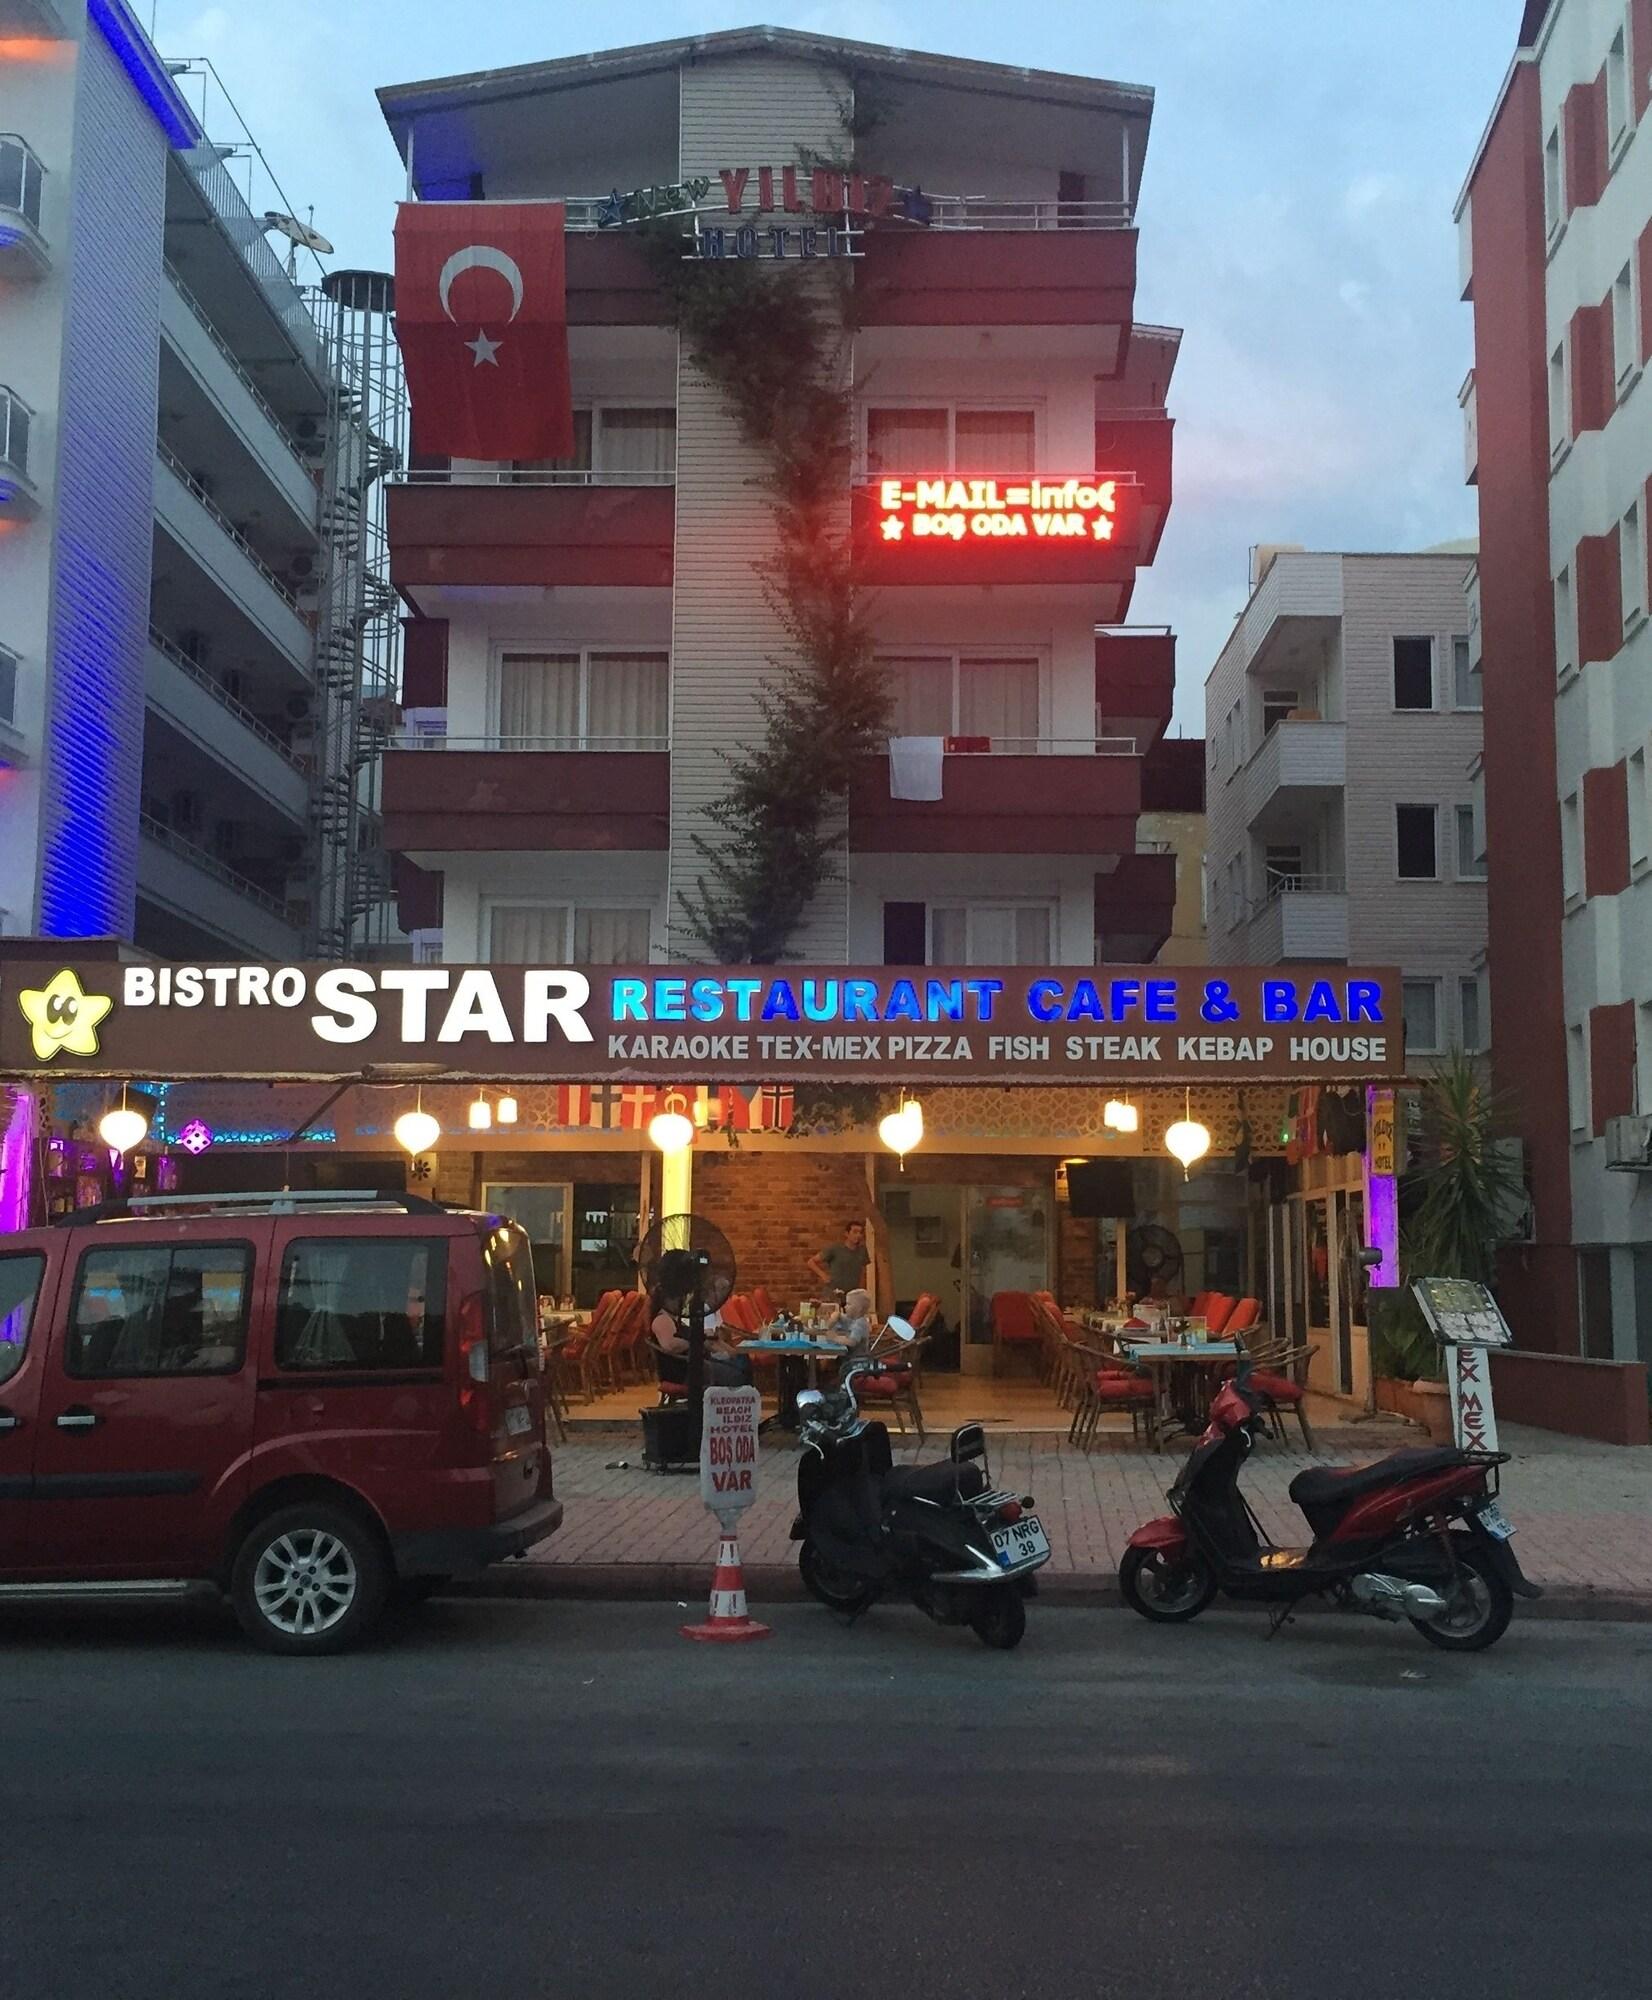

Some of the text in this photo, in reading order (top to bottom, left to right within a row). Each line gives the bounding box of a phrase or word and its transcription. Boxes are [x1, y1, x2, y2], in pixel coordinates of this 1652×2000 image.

[703, 226, 839, 259] HOTEL
[912, 513, 1087, 541] BOŞ ODA VAR
[123, 967, 594, 1044] BISTRO STAR
[611, 978, 1385, 1022] RESTAURANT CAFE & BAR
[607, 1035, 1387, 1062] KARAOKE TEX-MEX PIZZA FISH STEAK KEBAP HOUSE
[716, 1406, 751, 1415] BEACH
[1460, 1392, 1487, 1449] MEX
[710, 1425, 754, 1434] HOTEL
[735, 1435, 755, 1463] ODA
[711, 1470, 752, 1493] VAR
[994, 1520, 1040, 1548] 07 NRG
[1019, 1540, 1036, 1556] 38
